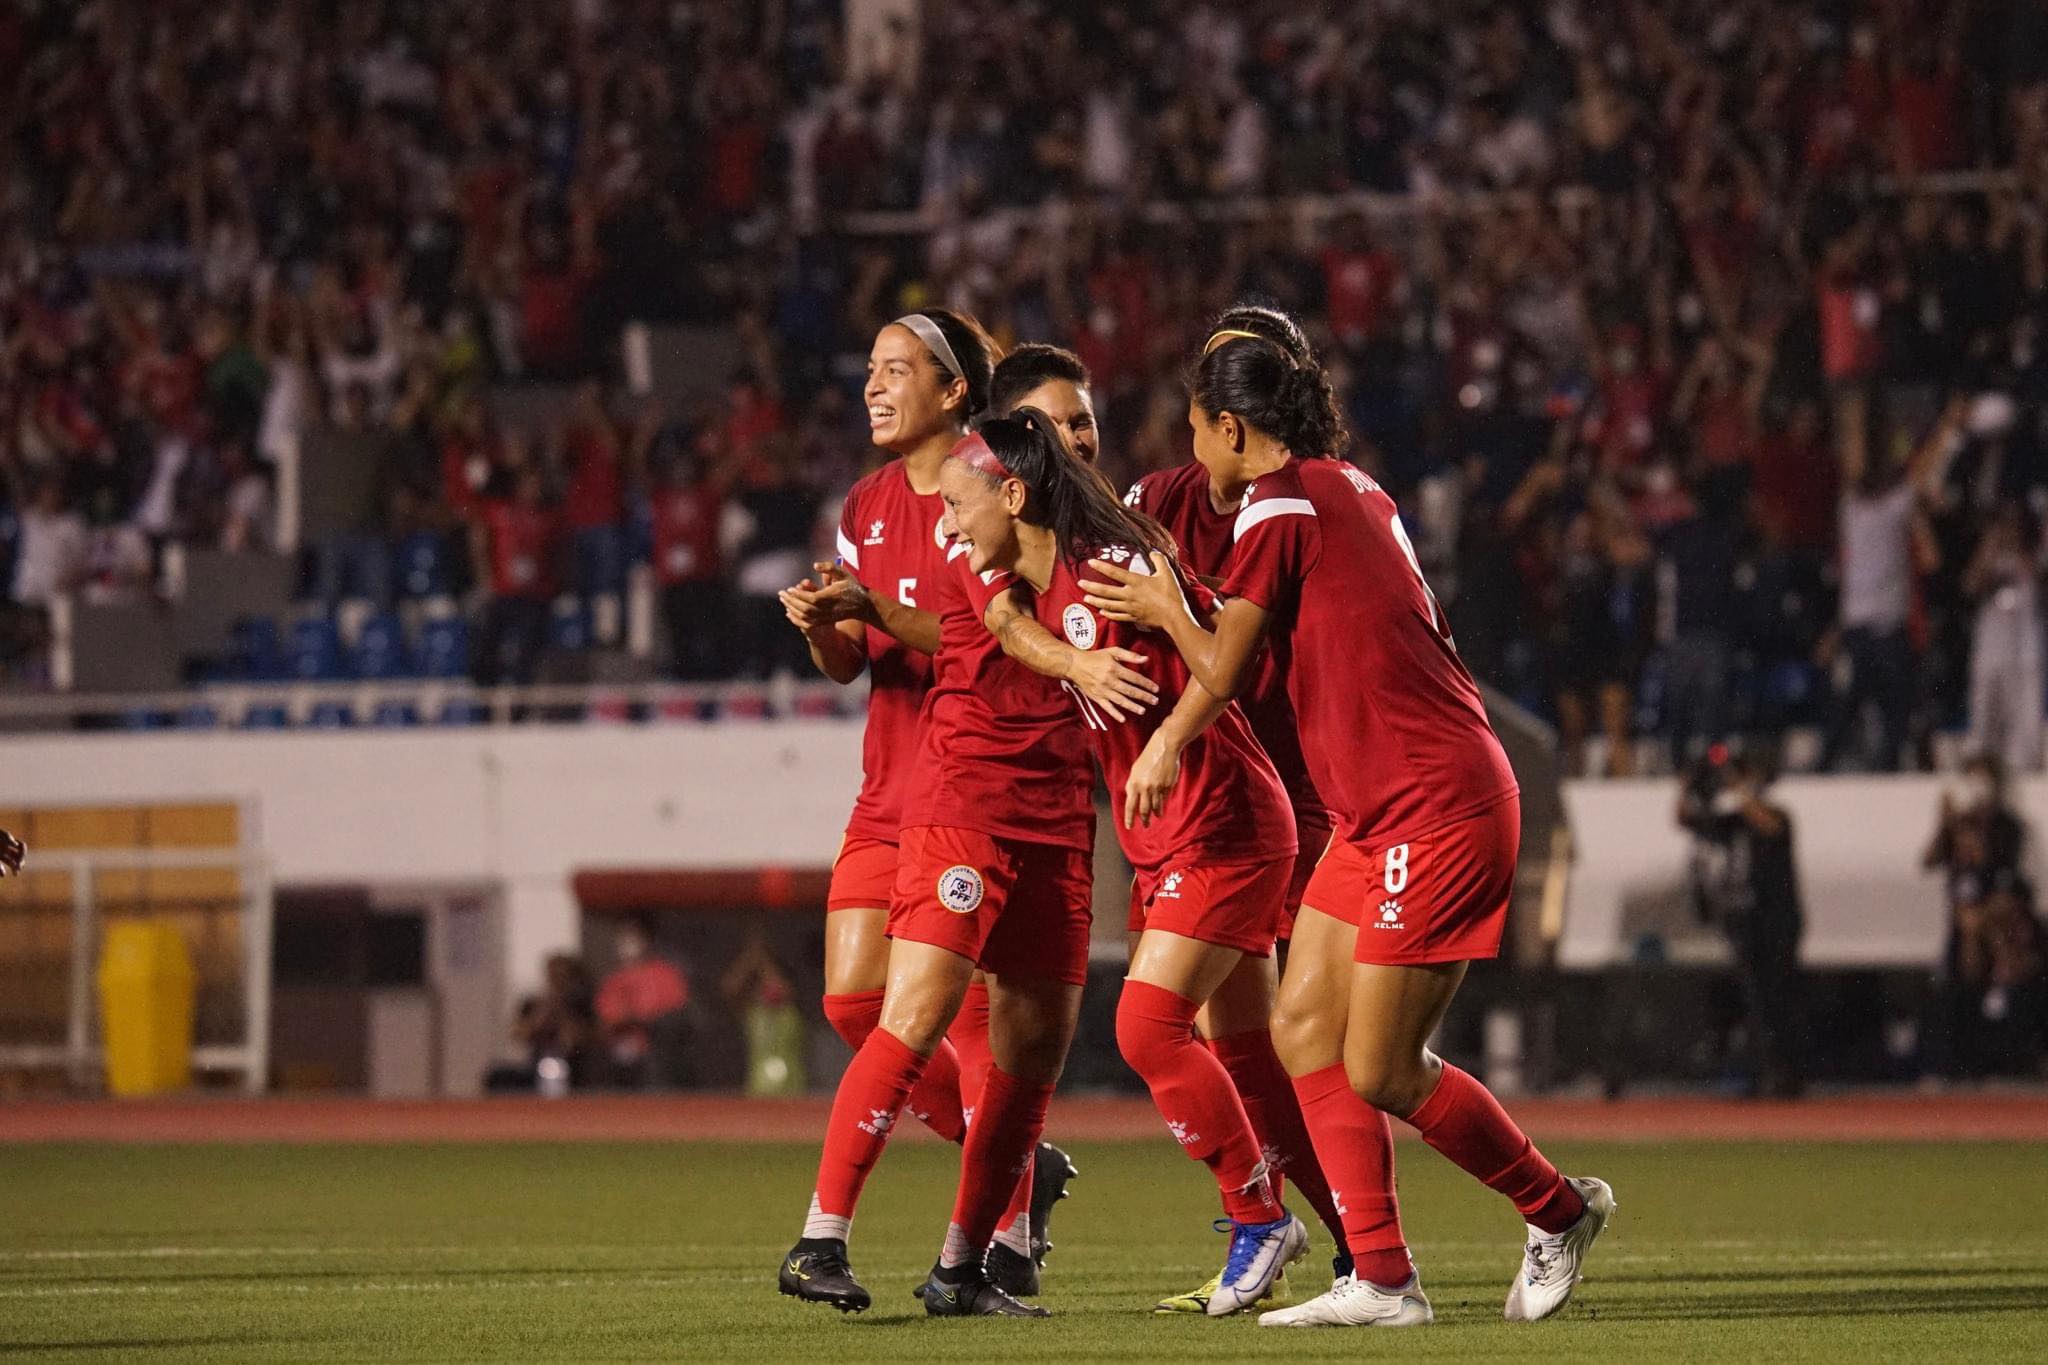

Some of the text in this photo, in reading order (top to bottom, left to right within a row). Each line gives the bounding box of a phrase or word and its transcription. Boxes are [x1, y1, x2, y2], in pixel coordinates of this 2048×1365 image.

[899, 578, 917, 608] 5
[1075, 629, 1089, 639] PFF
[1384, 843, 1409, 894] 8
[950, 890, 972, 902] PFF
[1374, 922, 1405, 930] KELME
